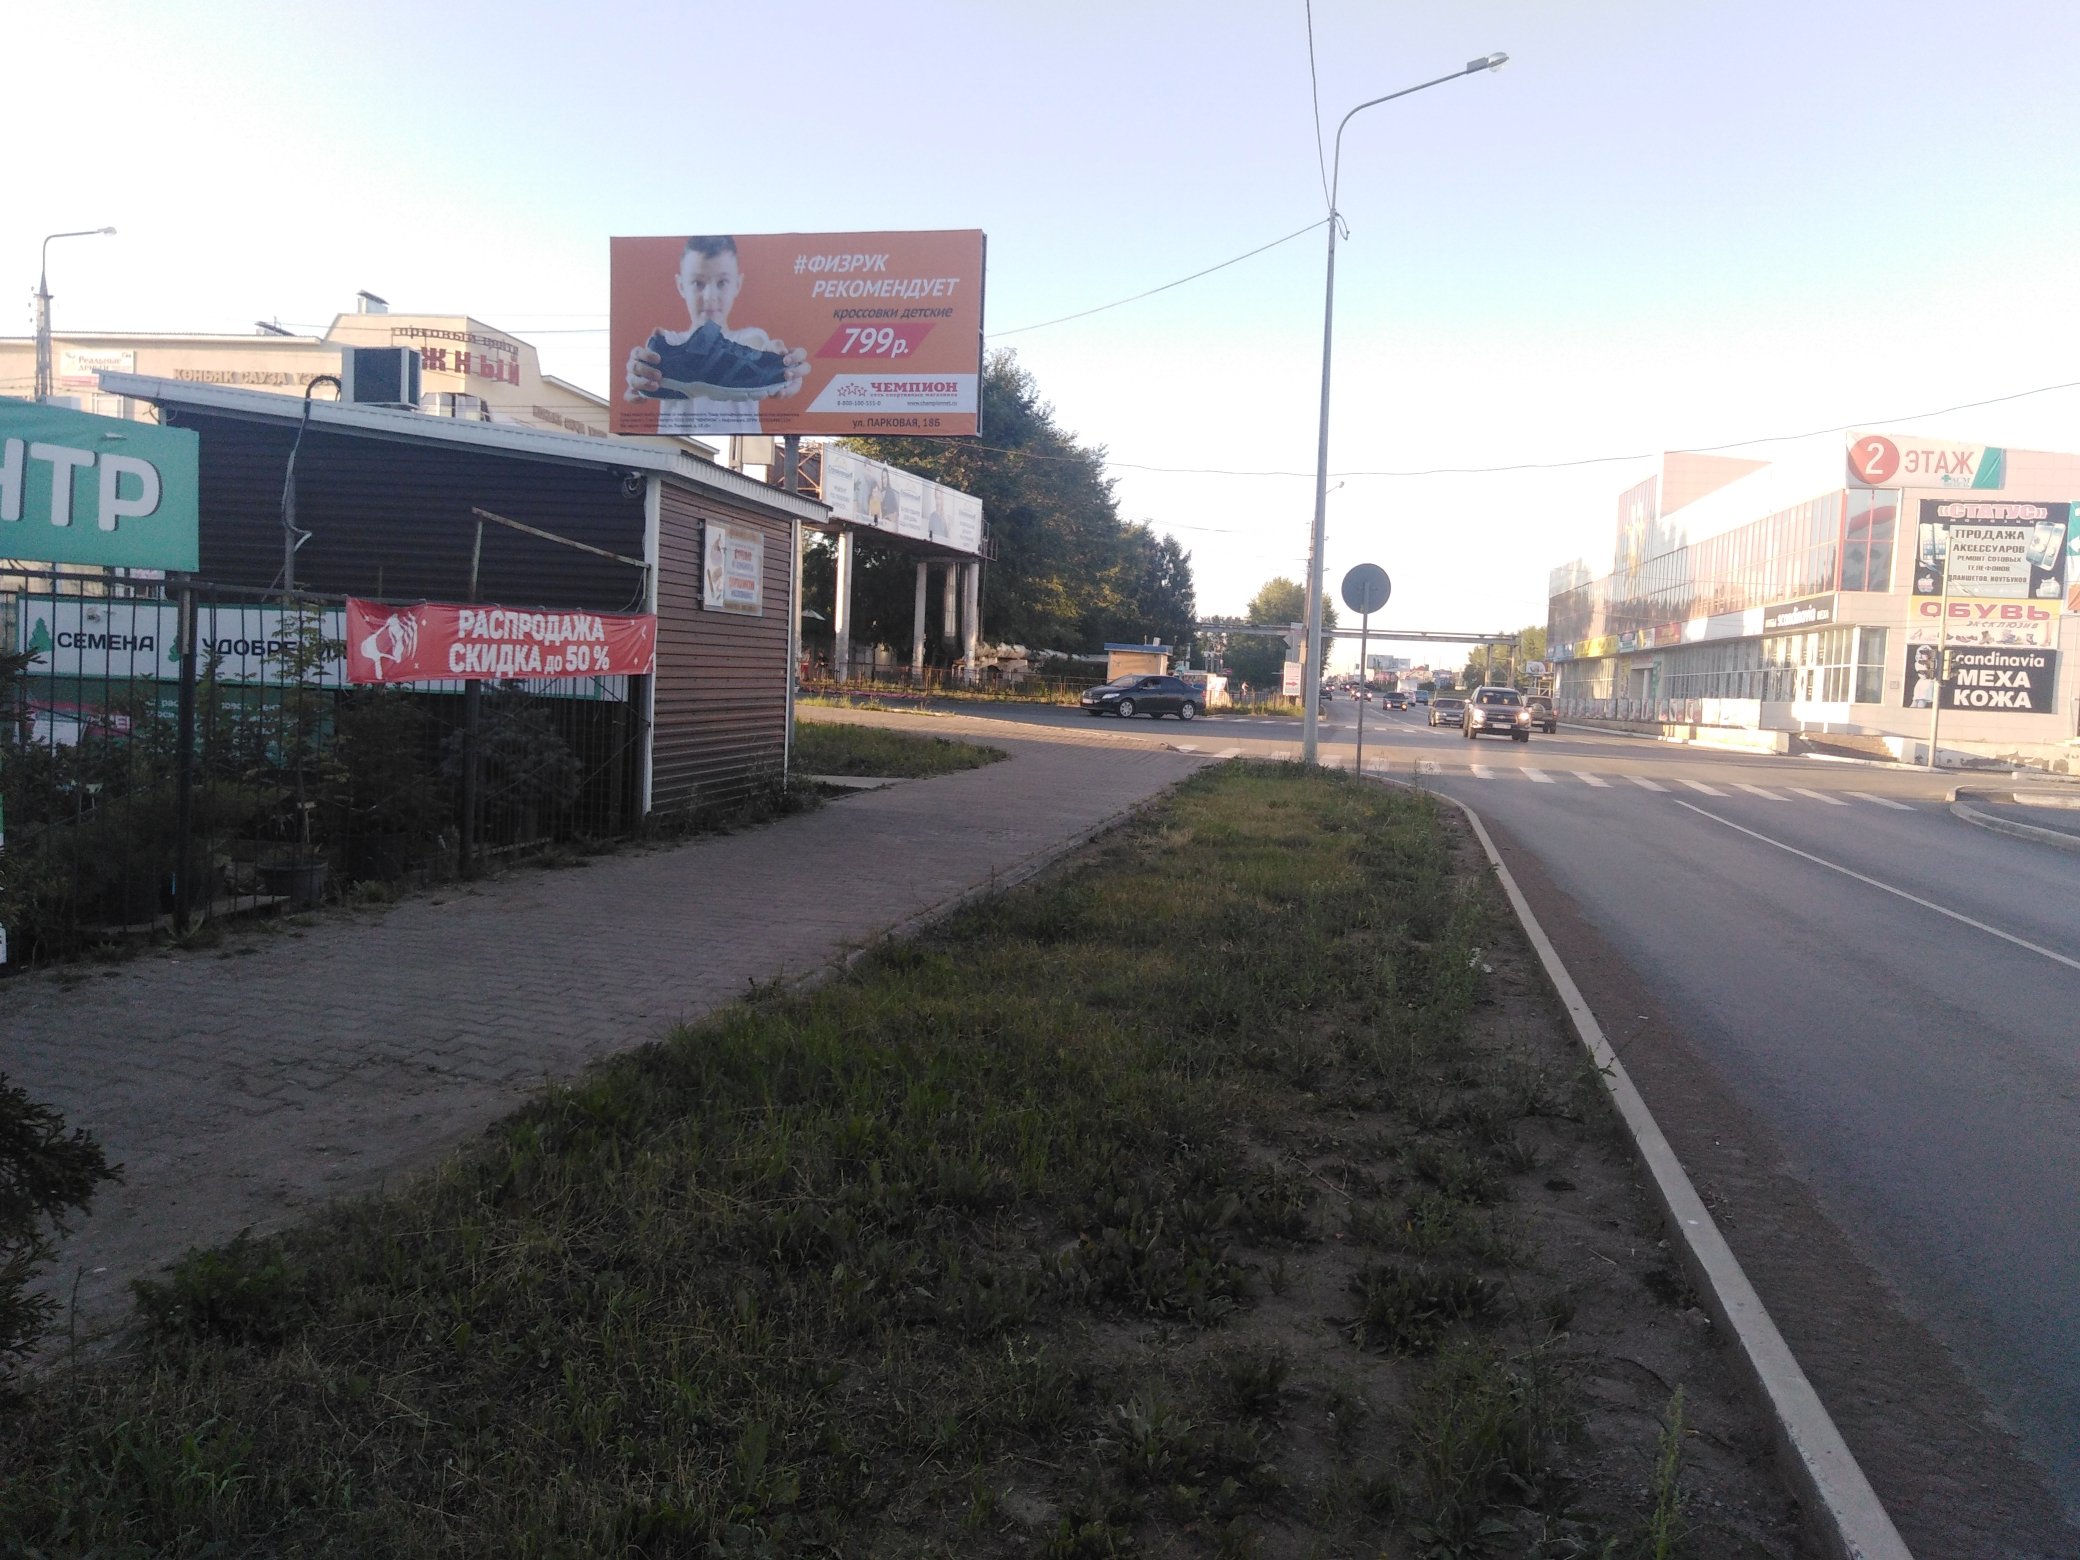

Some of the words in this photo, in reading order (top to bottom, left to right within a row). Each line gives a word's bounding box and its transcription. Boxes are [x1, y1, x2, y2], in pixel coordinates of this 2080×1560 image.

[794, 254, 889, 274] #ФИЗРУК
[812, 278, 960, 299] РЕКОМЕНДУЕТ
[833, 308, 898, 321] кроссовки
[900, 307, 953, 319] детские
[870, 382, 958, 393] ЧЕМПИОН
[852, 419, 865, 429] ул.
[867, 418, 921, 429] ПАРКОВАЯ,
[923, 418, 940, 427] 18Б
[1865, 442, 1885, 475] 2
[1905, 450, 1974, 475] ЭТАЖ
[1955, 529, 2025, 541] ПРОДАЖА
[1953, 543, 2025, 554] АКСЕССУАРОВ
[1987, 555, 2022, 563] СОТОВЫХ
[1920, 602, 2050, 620] ОБУВЬ
[458, 610, 605, 646] РАСПРОДАЖА
[1966, 621, 2039, 629] ЭКСКЛЮЗИВ
[57, 632, 154, 652] СЕМЕНА
[449, 643, 543, 678] СКИДКА
[544, 656, 562, 674] до
[566, 645, 590, 671] 50
[593, 646, 610, 671] %
[1951, 652, 2045, 668] candinavia
[1957, 669, 2032, 688] МЕХА
[1953, 689, 2033, 708] КОЖА
